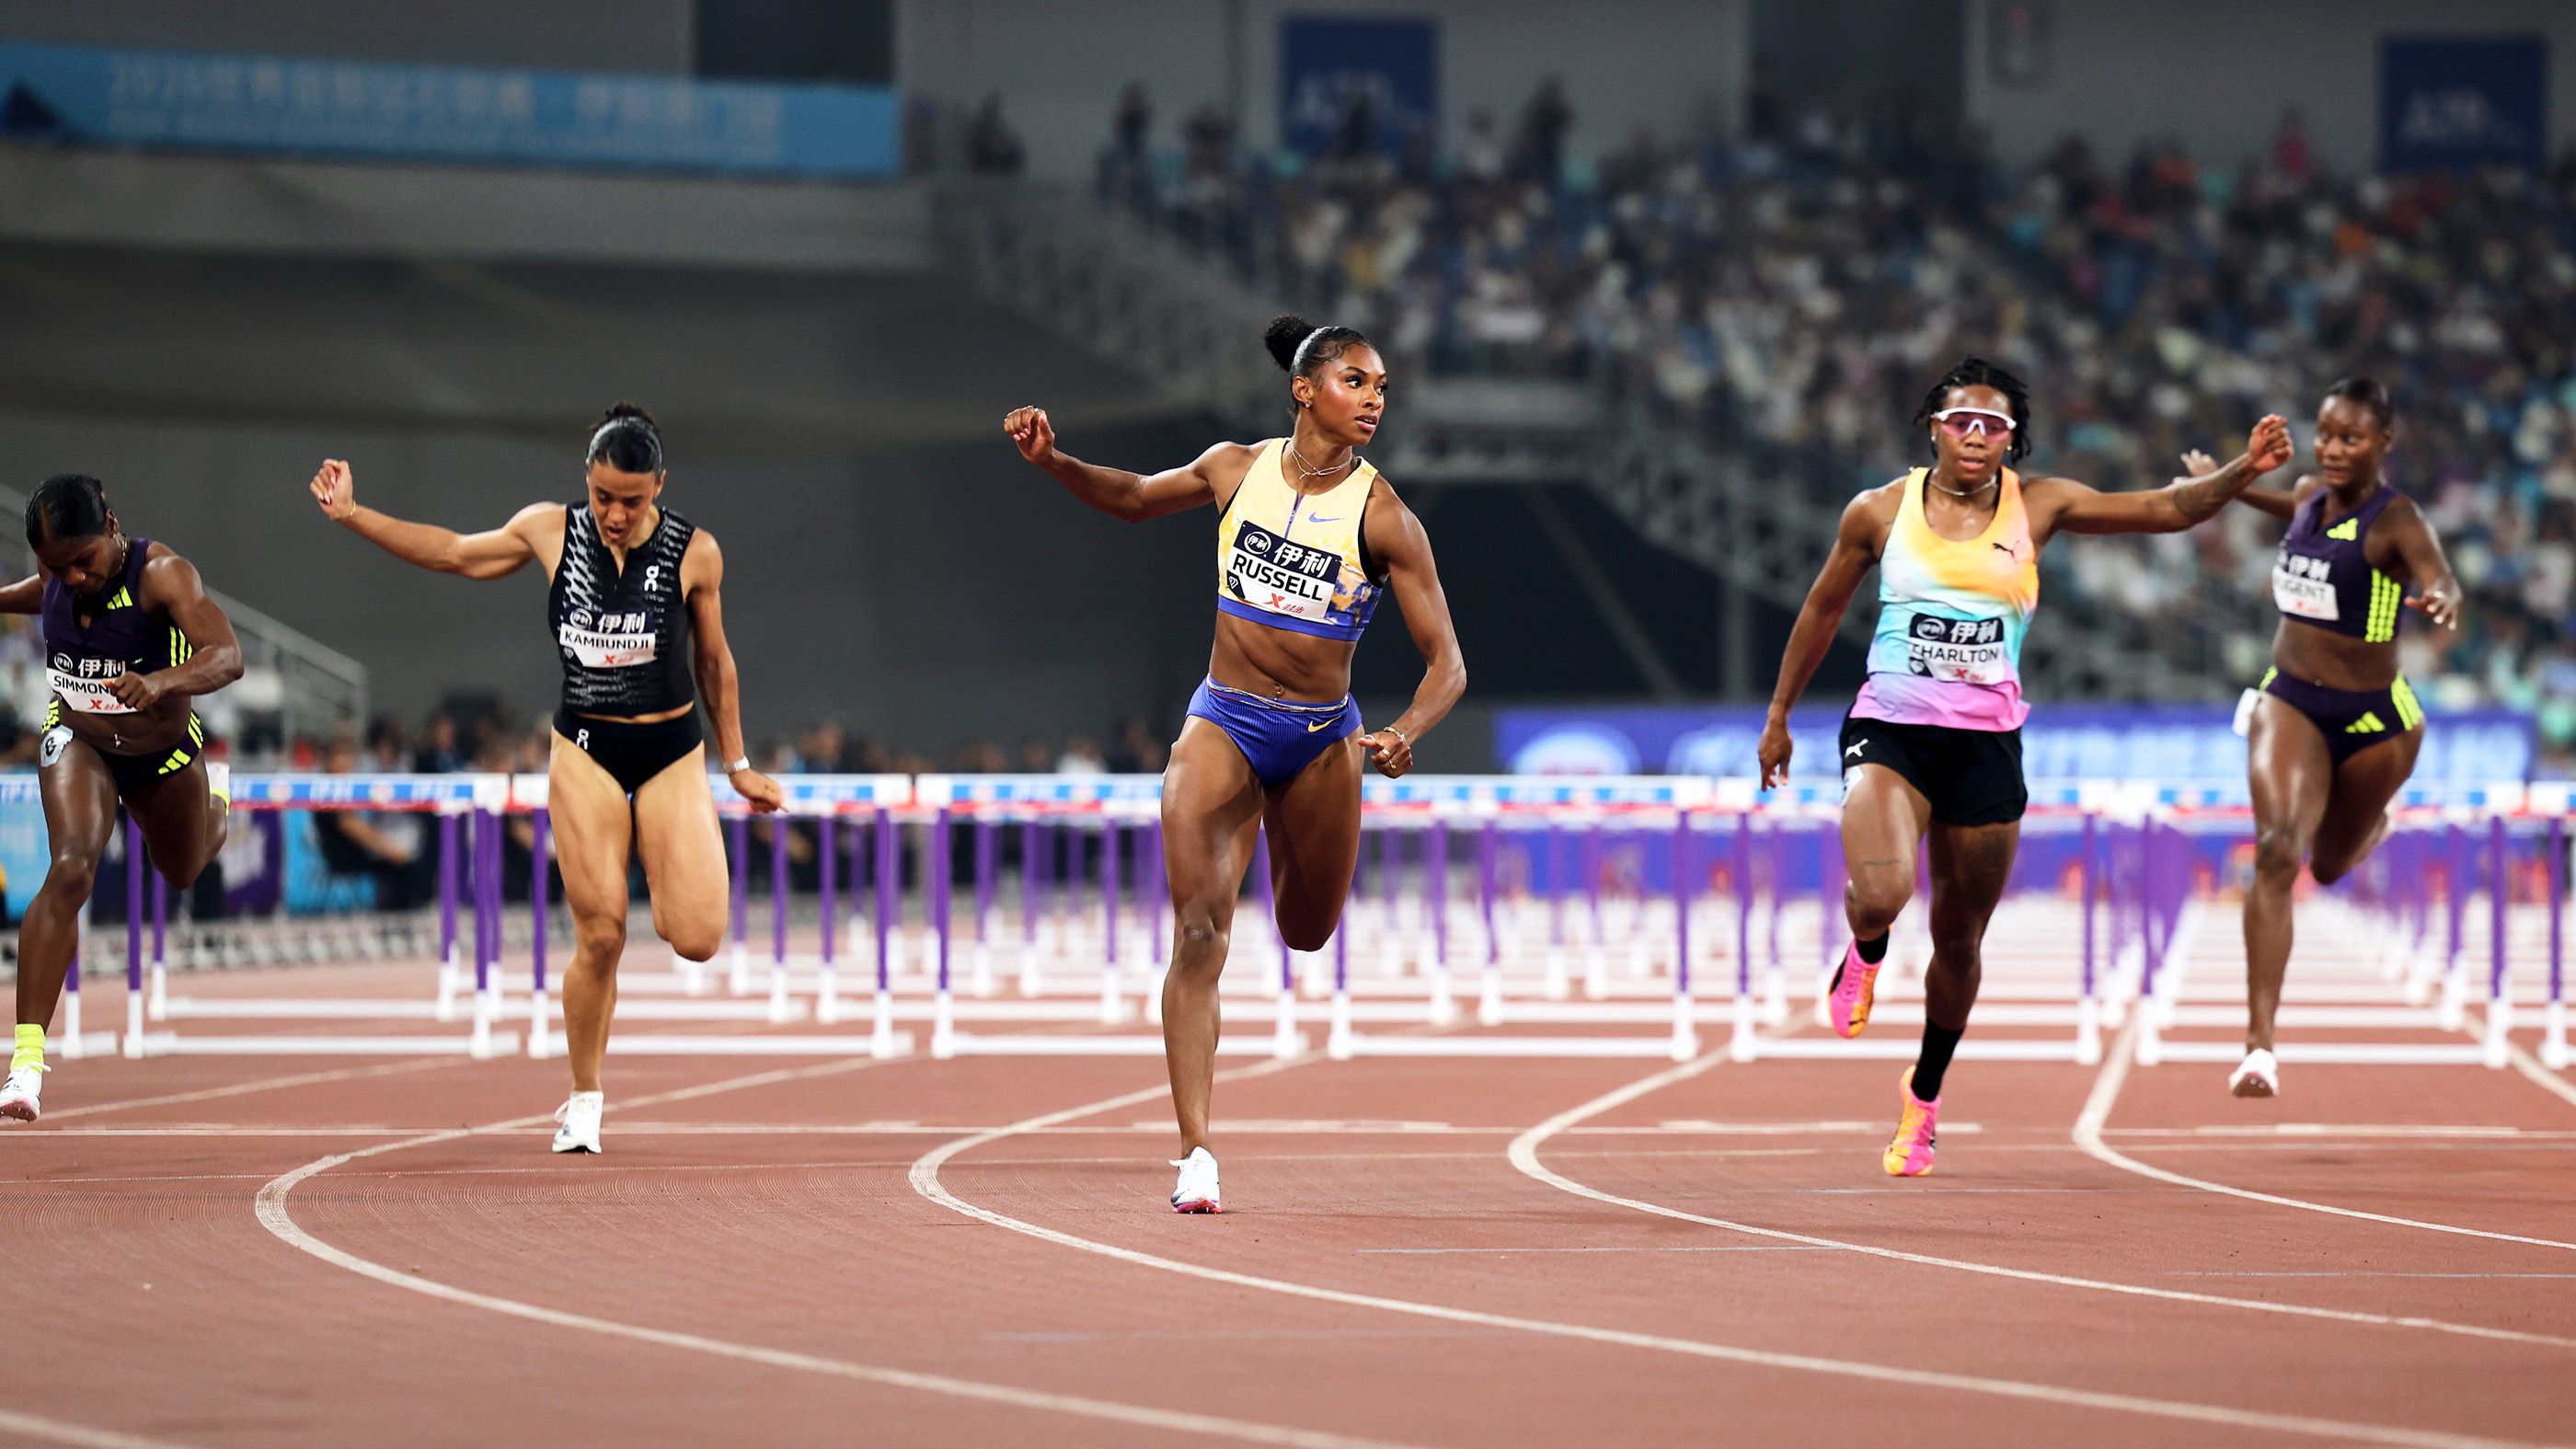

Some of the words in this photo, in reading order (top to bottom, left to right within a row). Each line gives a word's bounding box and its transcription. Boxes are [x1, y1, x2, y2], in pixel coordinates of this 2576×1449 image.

[1273, 542, 1332, 578] 伊利
[1233, 553, 1322, 601] RUSSELL
[598, 612, 646, 633] 伊利
[1950, 620, 1998, 643] 伊利
[565, 631, 649, 649] KAMBUNDJI
[78, 658, 126, 677] 伊利
